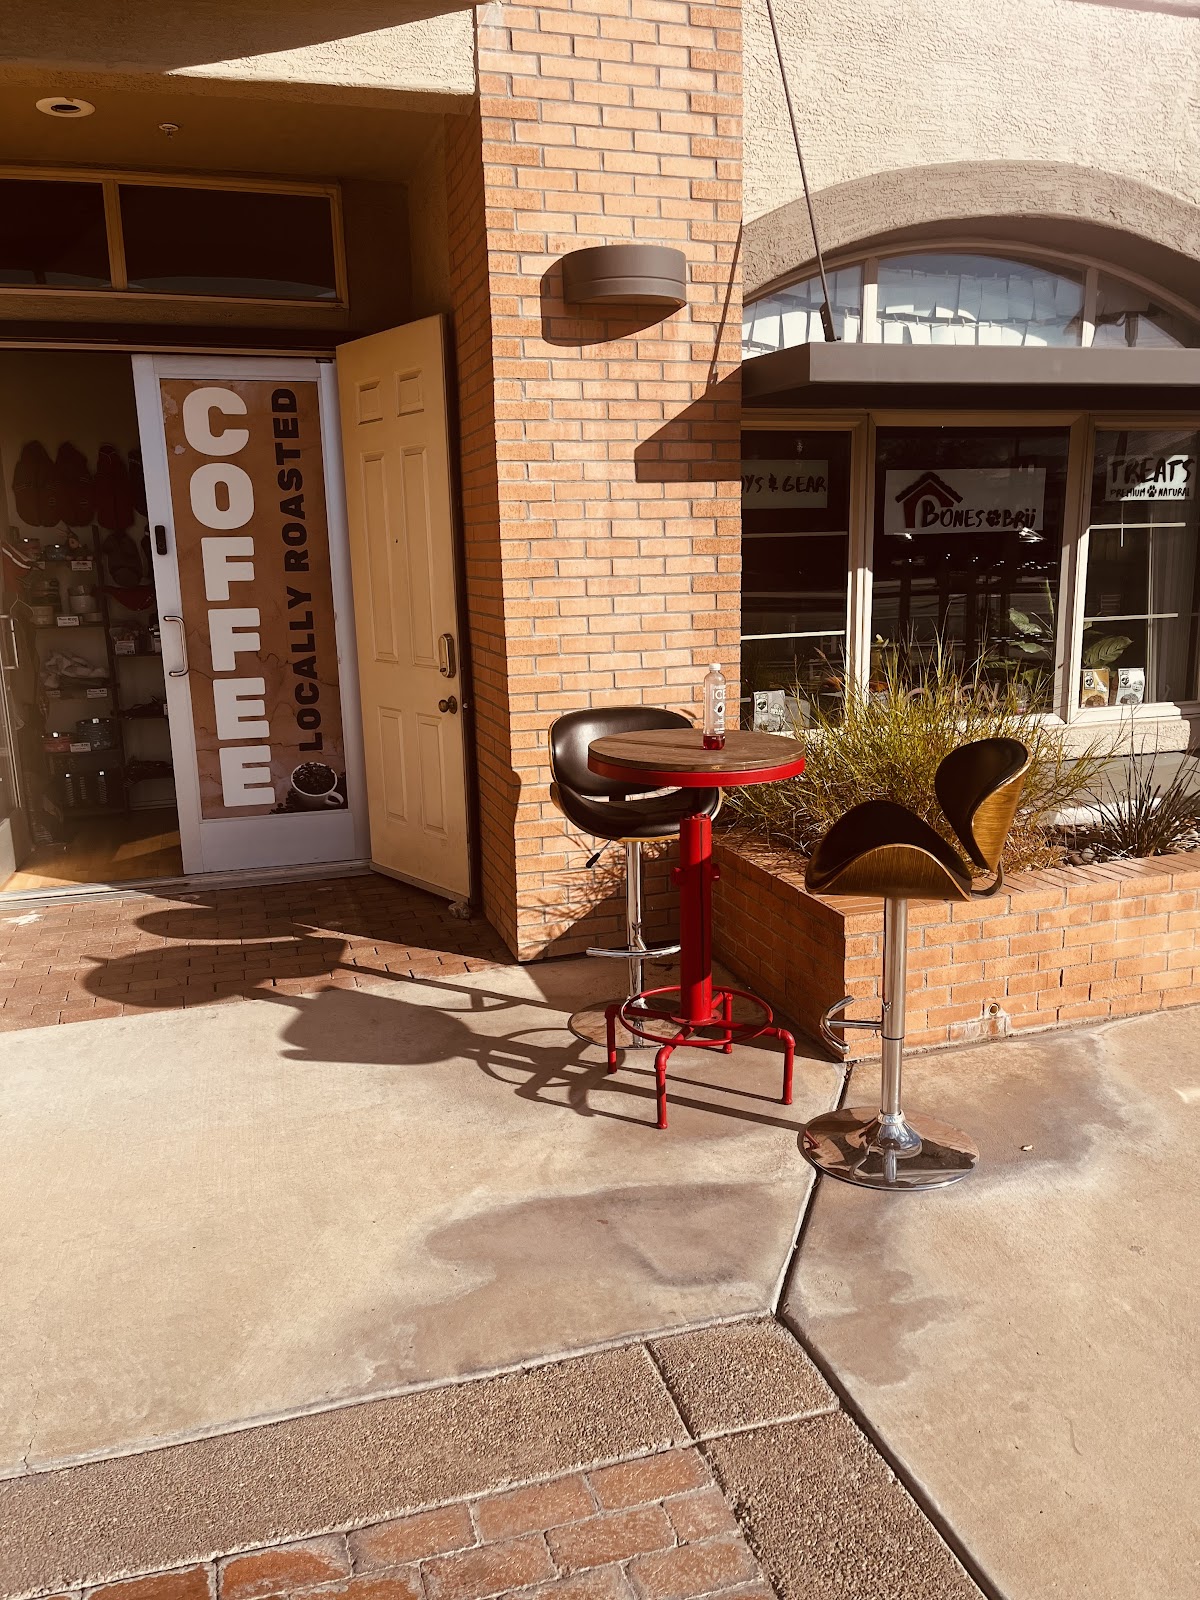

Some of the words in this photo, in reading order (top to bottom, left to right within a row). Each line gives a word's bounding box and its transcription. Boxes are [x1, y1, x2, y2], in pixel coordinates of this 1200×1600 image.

[271, 389, 309, 572] ROASTED
[782, 476, 827, 493] GEAR
[1110, 457, 1195, 484] TREATS
[1110, 487, 1146, 498] PREMIUM
[1158, 487, 1190, 497] NATURAL
[921, 500, 985, 528] BONES
[183, 387, 275, 807] COFFEE
[284, 587, 322, 752] LOCALLY
